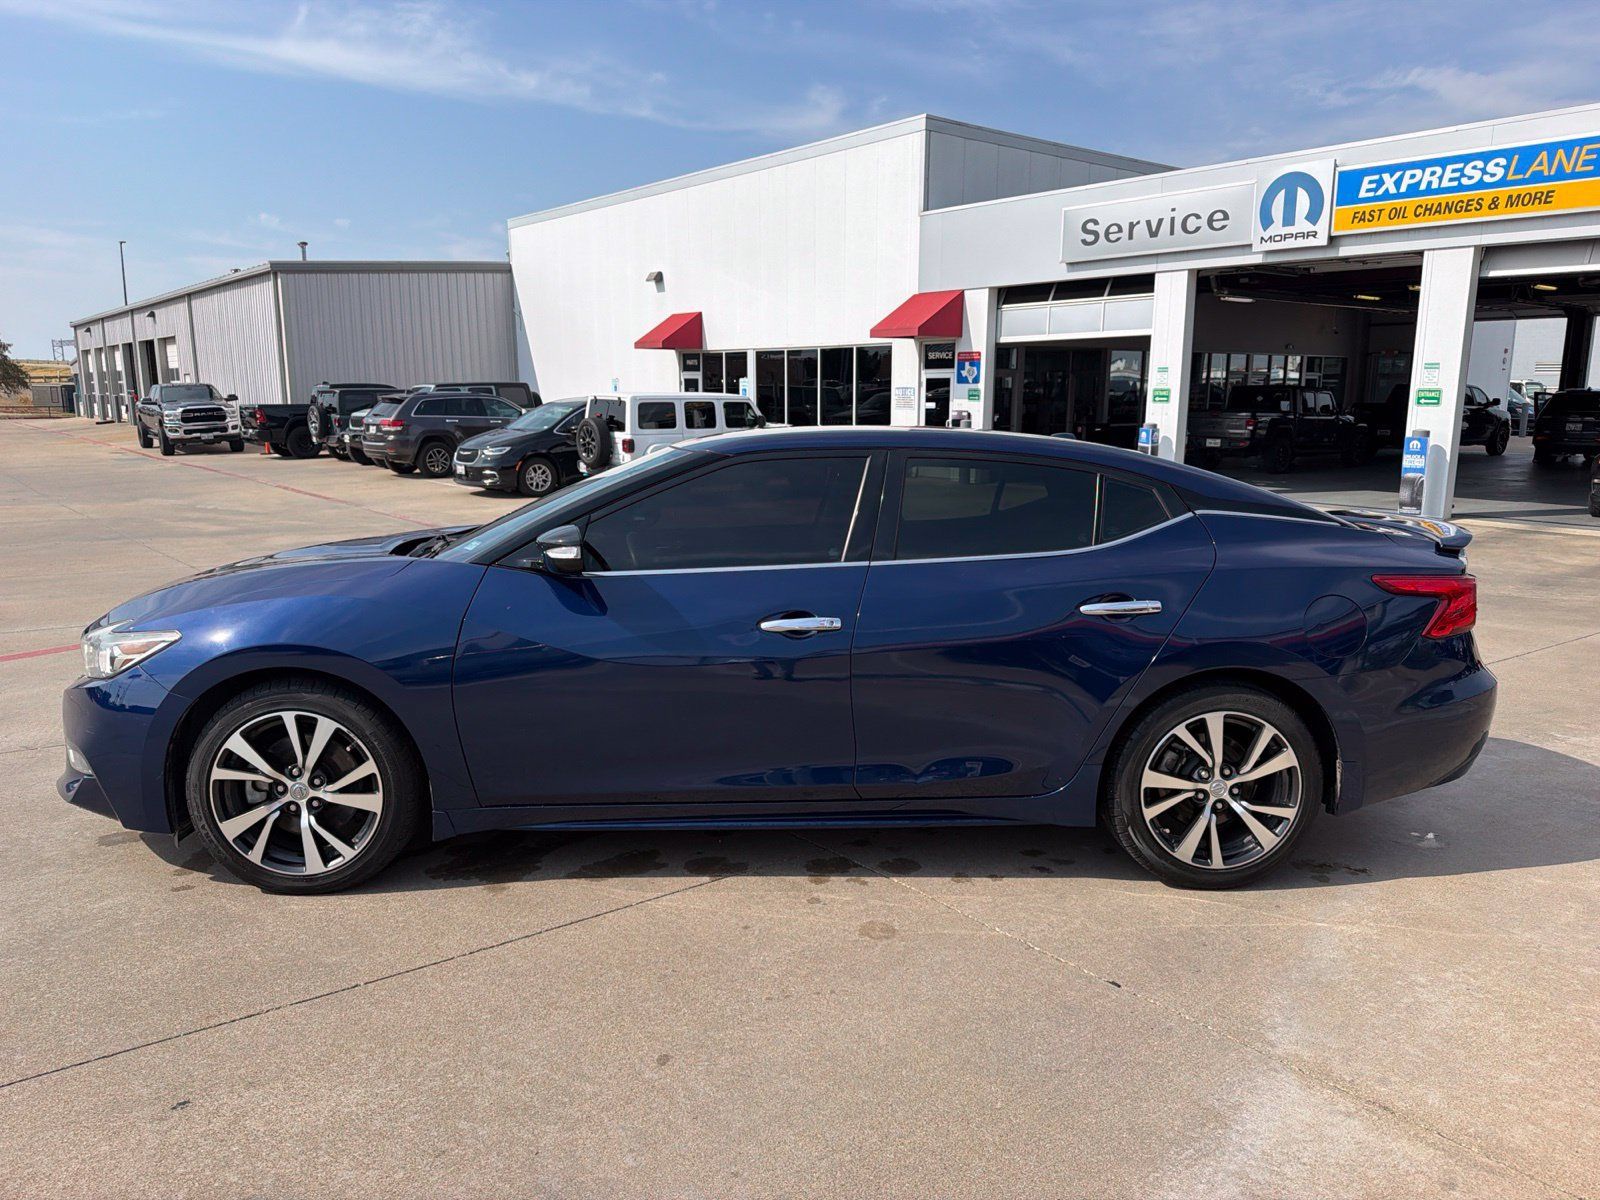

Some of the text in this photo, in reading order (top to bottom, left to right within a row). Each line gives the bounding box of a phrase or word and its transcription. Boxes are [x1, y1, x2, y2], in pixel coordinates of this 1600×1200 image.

[1351, 190, 1556, 225] FAST OIL CHANGES & MORE
[1080, 208, 1230, 247] Service
[1260, 230, 1319, 245] MOPAR
[928, 352, 953, 360] SERVICE
